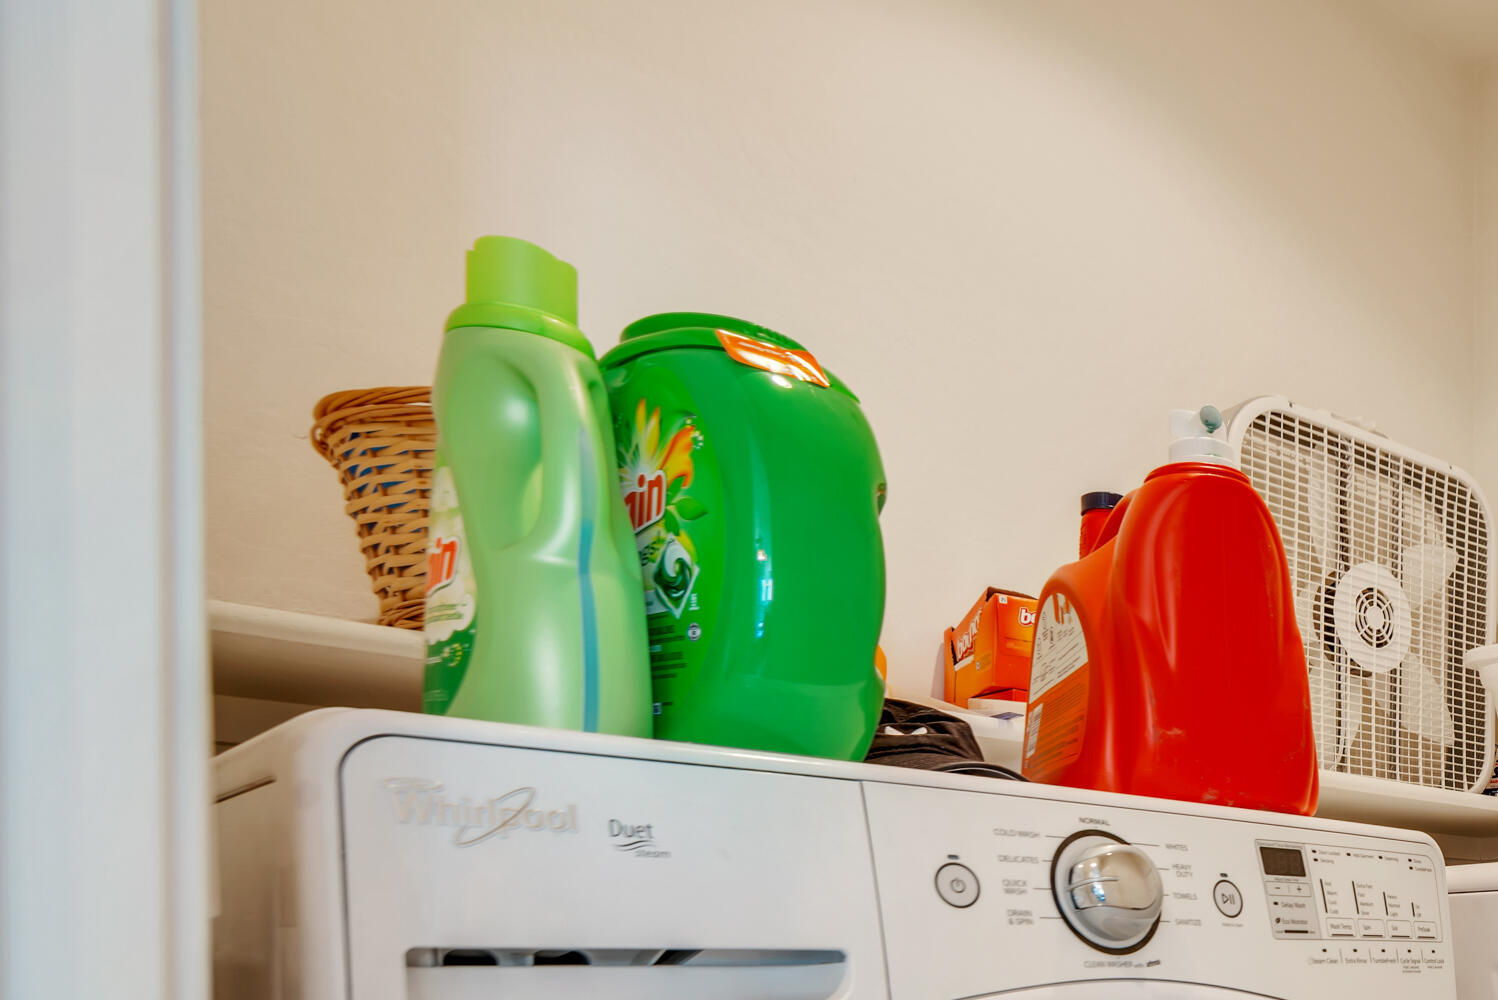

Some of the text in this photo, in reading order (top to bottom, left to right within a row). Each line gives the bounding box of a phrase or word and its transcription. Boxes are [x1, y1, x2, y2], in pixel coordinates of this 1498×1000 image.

[392, 791, 655, 843] Whirlpool Duet
[1078, 817, 1110, 826] NORMAL
[993, 828, 1016, 837] COLD
[997, 854, 1039, 864] DELICATES
